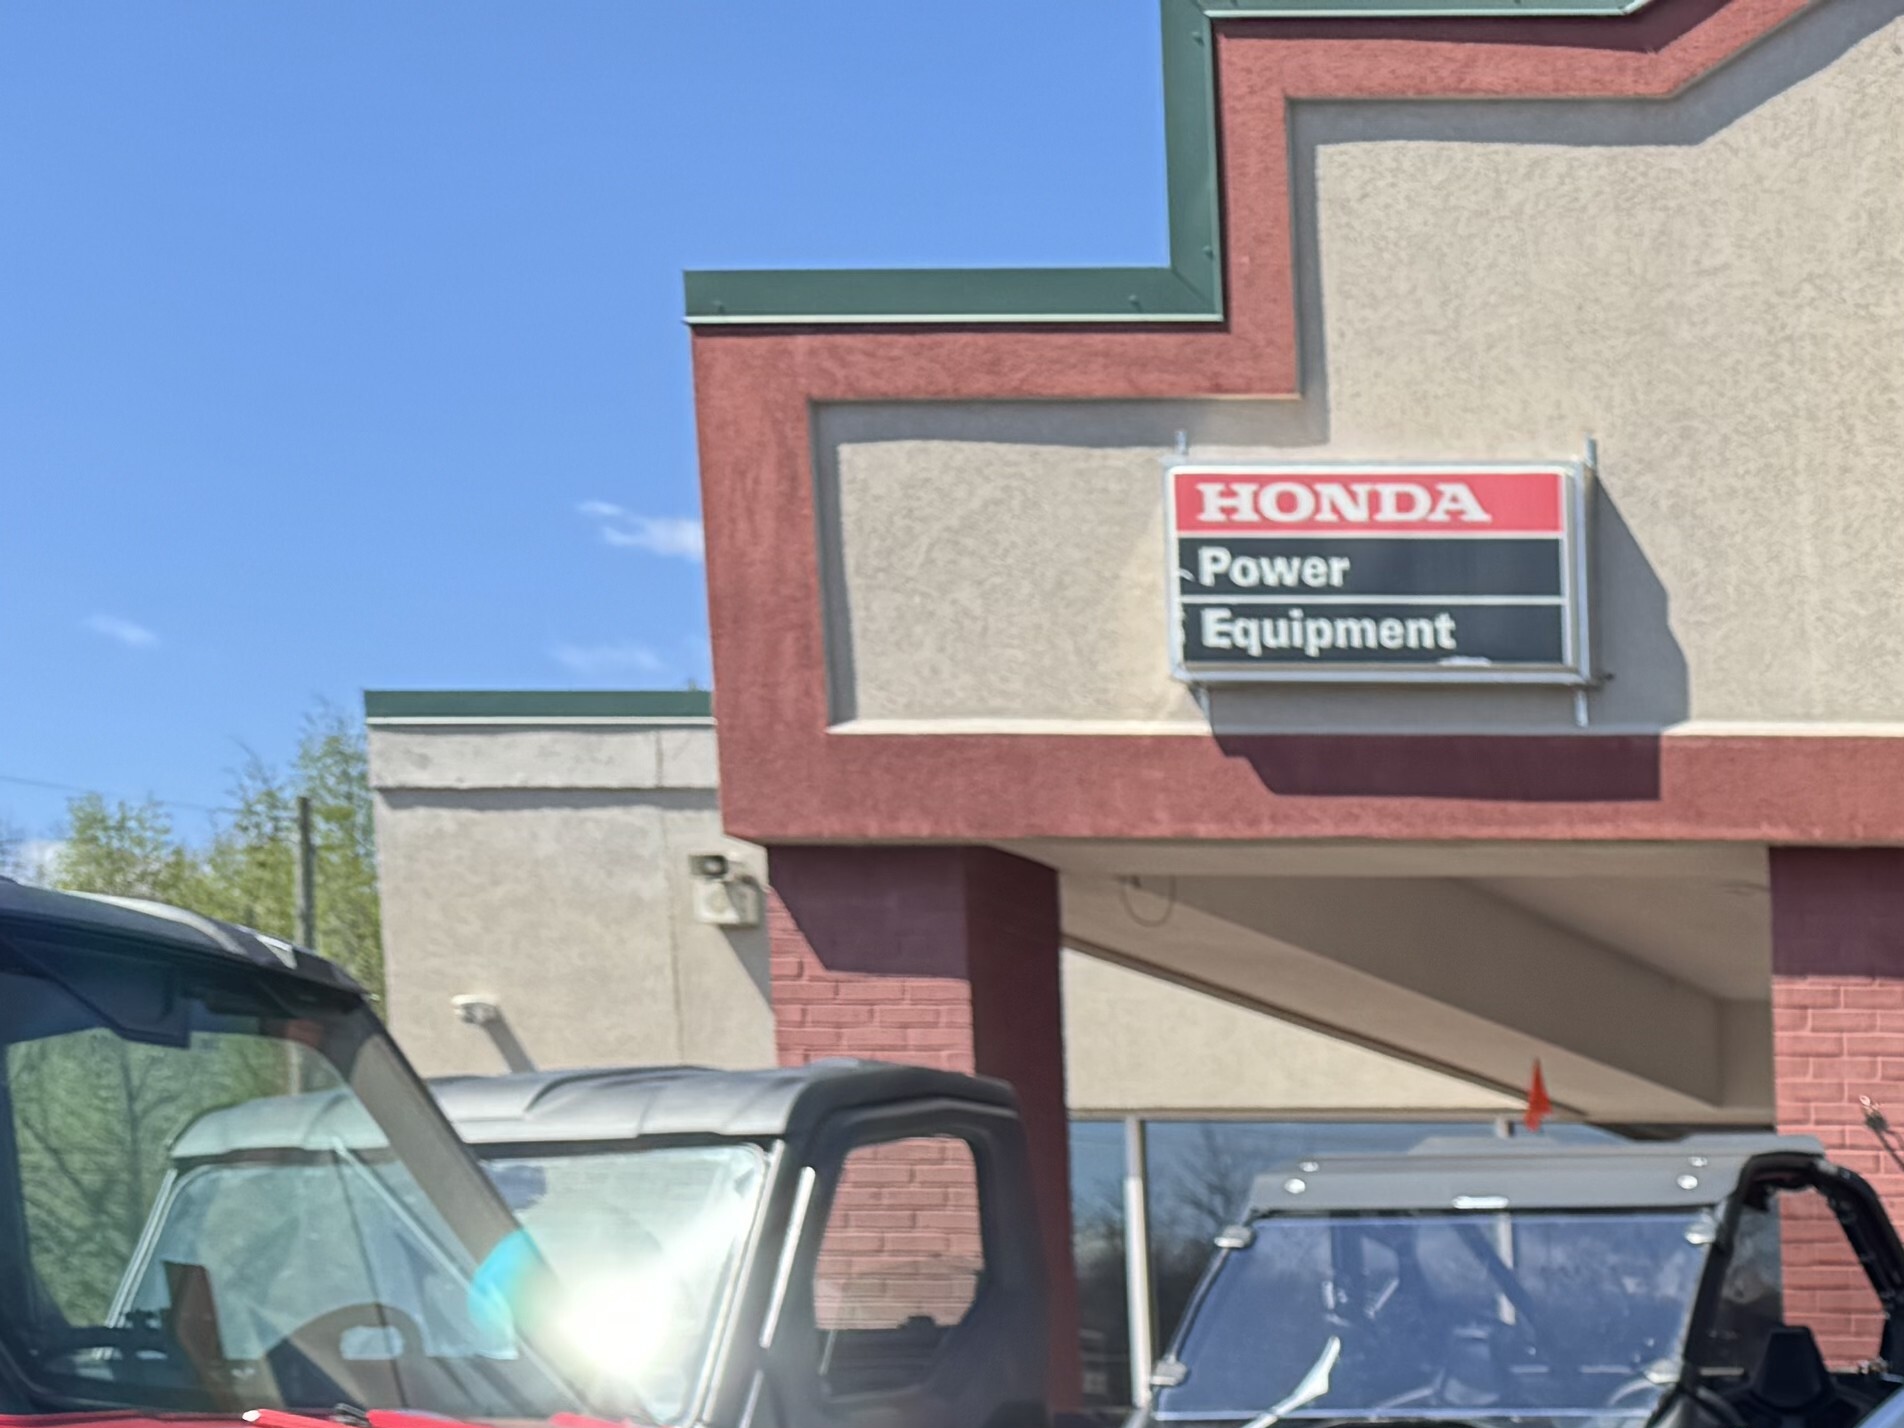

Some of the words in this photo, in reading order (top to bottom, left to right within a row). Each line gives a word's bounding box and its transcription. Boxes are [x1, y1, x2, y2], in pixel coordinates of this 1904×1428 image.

[1196, 483, 1491, 522] HONDA
[1199, 547, 1350, 587] Power
[1201, 608, 1456, 656] Equipment
